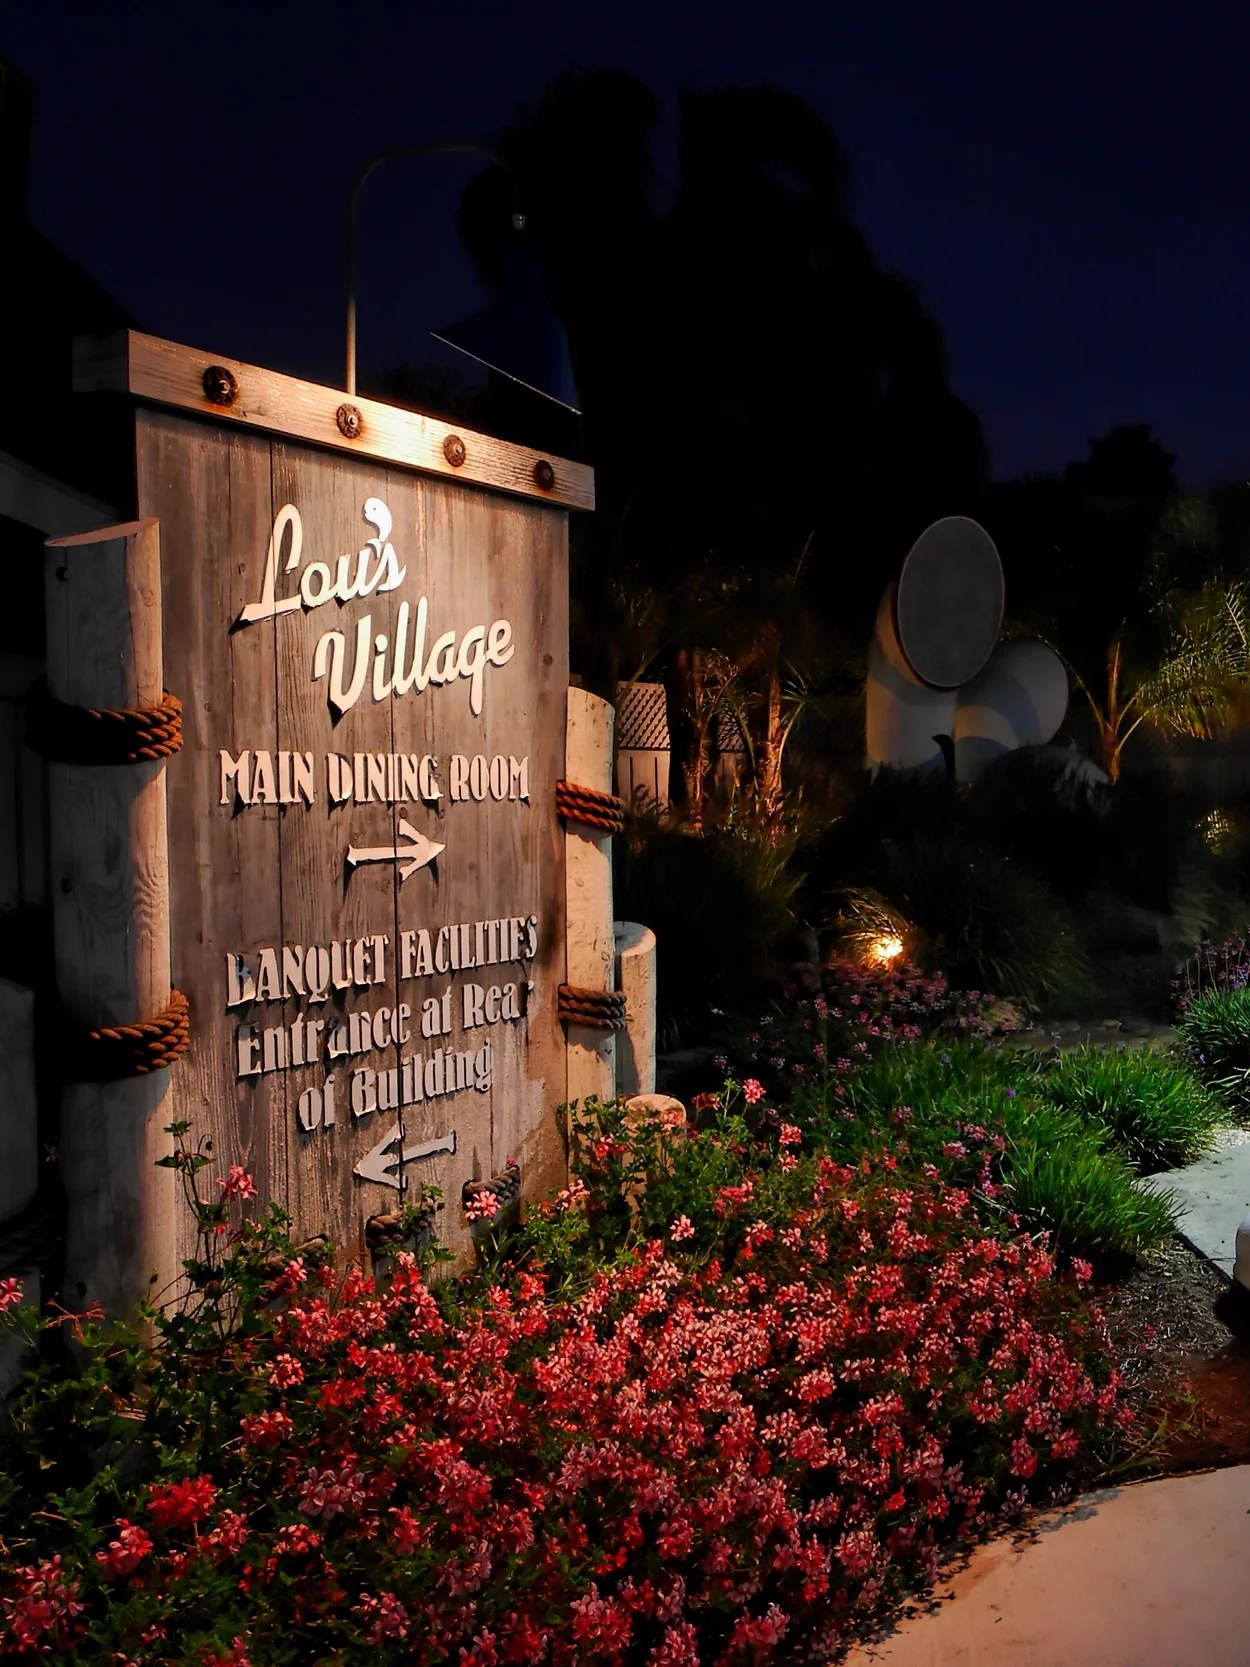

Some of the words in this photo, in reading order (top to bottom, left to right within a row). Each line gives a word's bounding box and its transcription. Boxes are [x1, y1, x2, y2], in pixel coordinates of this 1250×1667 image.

[238, 497, 407, 622] Lou's
[313, 596, 515, 716] Village
[219, 749, 315, 804] MAIN
[327, 752, 443, 802] DINING
[450, 753, 530, 802] ROOM
[225, 934, 390, 1007] BANQUET
[400, 914, 538, 980] FACILITIES
[237, 1000, 412, 1077] Entrance
[422, 985, 453, 1037] at
[298, 1073, 336, 1131] of
[351, 1038, 495, 1118] Building
